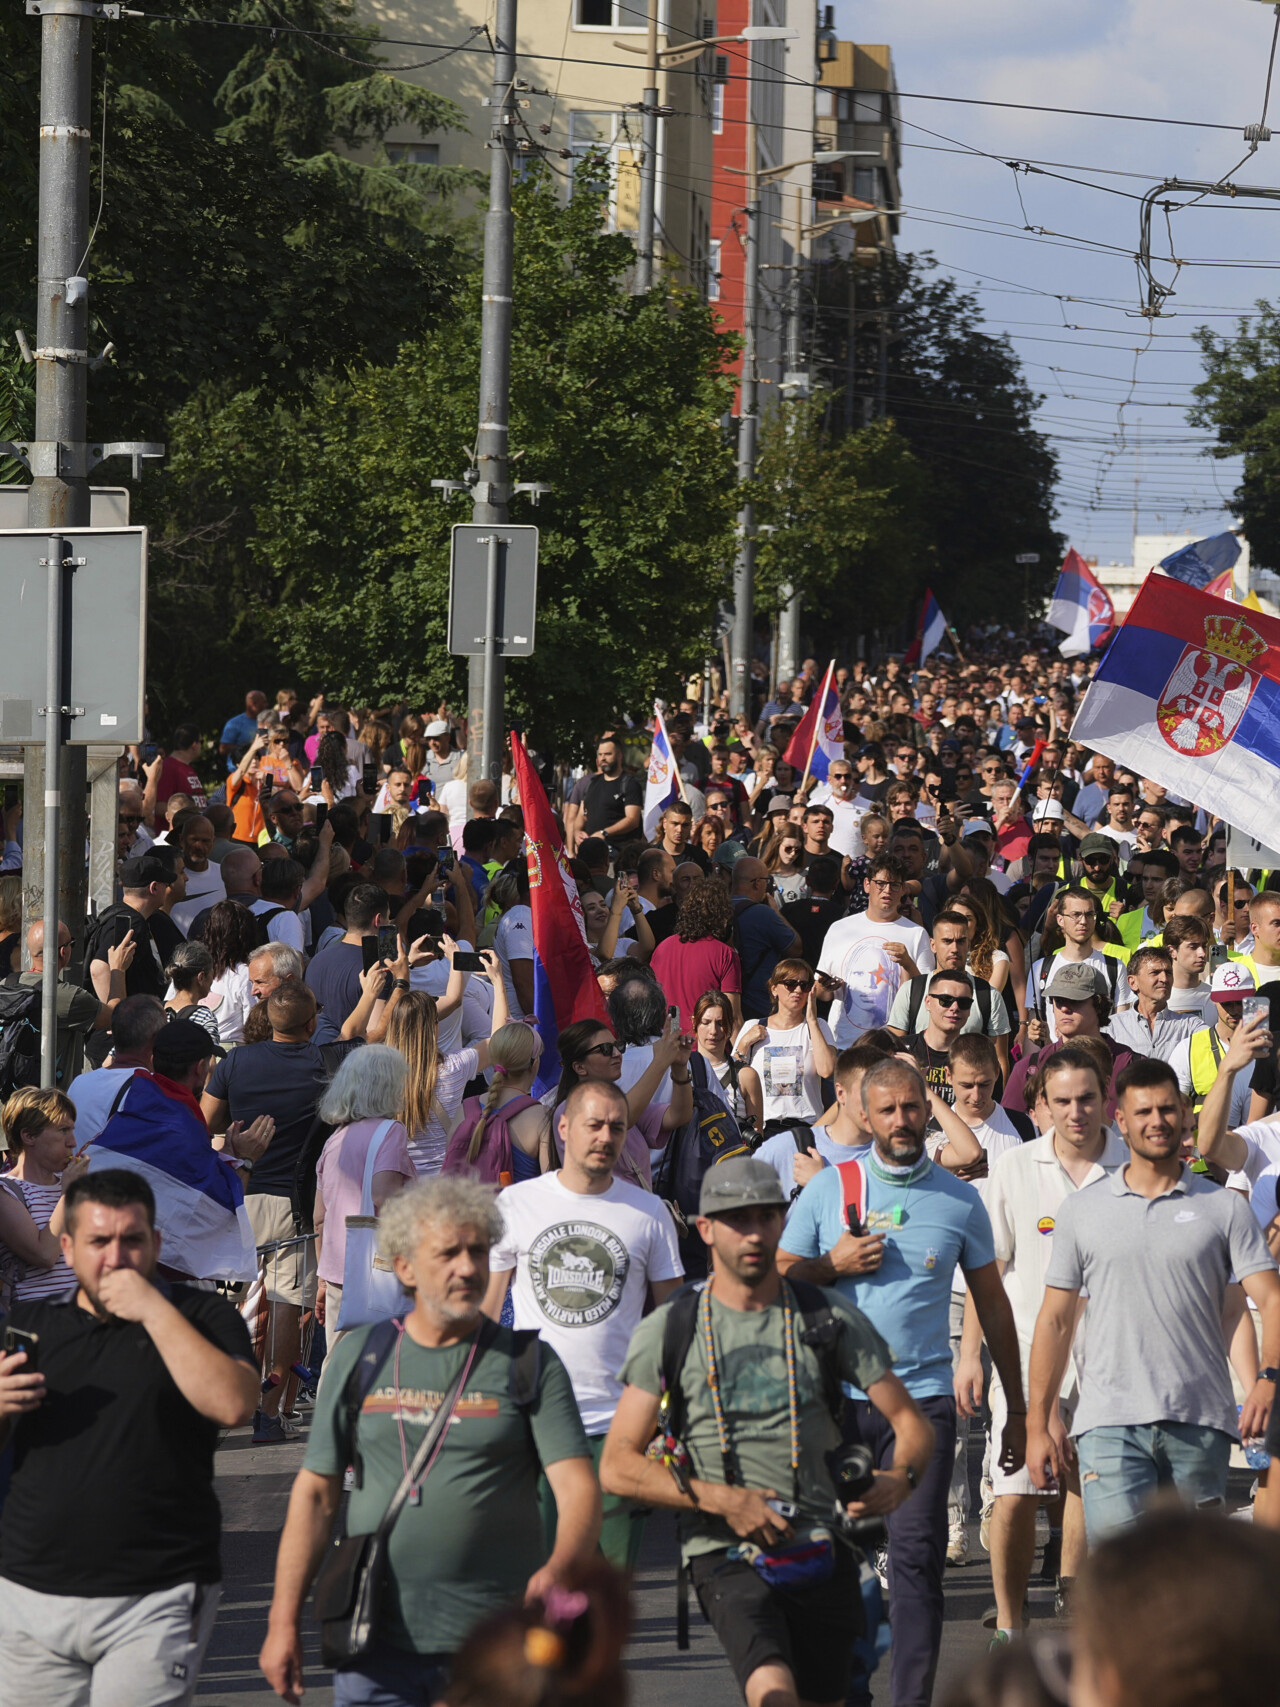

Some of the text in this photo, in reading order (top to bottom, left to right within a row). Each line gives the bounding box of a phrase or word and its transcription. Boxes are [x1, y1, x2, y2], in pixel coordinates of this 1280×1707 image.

[531, 1226, 568, 1268] LONSDALE
[567, 1224, 610, 1243] LONDON
[605, 1238, 627, 1276] BOXING
[547, 1264, 605, 1295] LONSDALE
[544, 1298, 584, 1324] MARTIAL
[584, 1297, 613, 1322] MIXED
